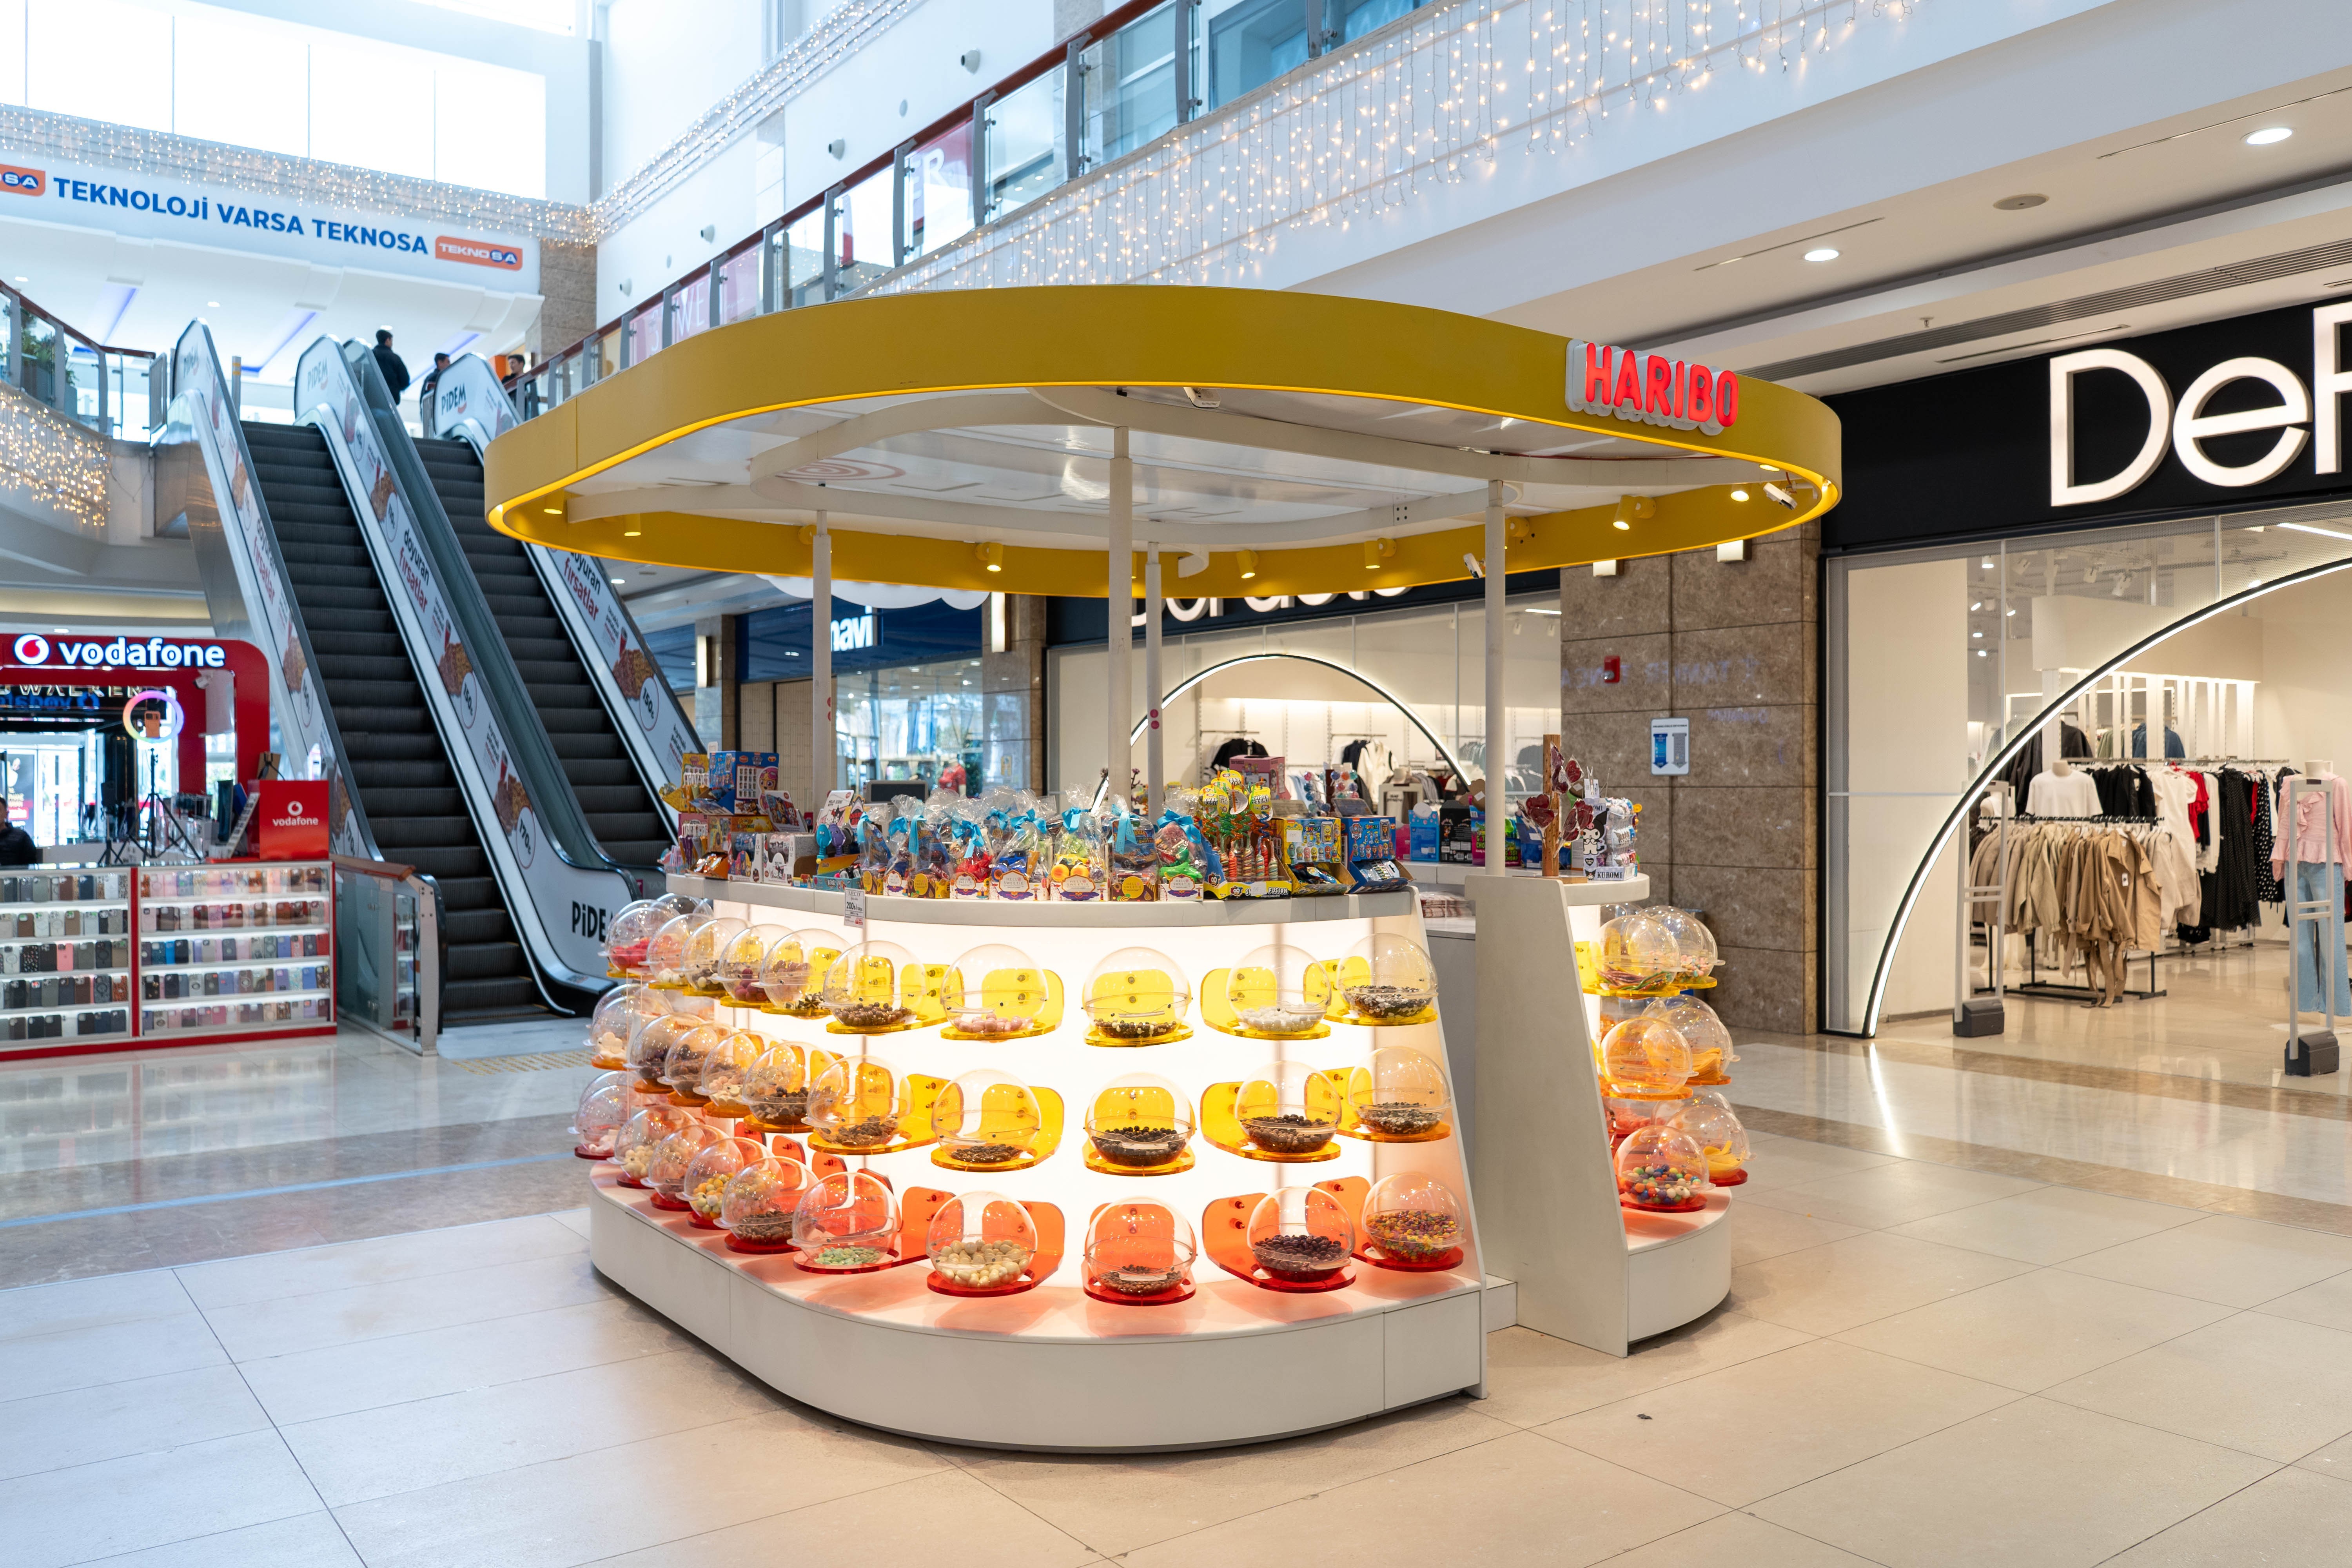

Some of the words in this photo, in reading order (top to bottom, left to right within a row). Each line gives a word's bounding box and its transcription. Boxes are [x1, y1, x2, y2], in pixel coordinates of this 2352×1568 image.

[0, 173, 38, 188] SA
[53, 177, 208, 220] TEKNOLOJİ
[217, 203, 304, 235] VARSA
[312, 219, 428, 255] TEKNOSA
[439, 242, 517, 263] TEKNOSA
[1585, 342, 1739, 427] HARIBO
[399, 546, 428, 613] fırsatlar
[404, 529, 429, 586] doyuran
[564, 557, 599, 621] fırsatlar
[58, 636, 226, 667] vodafone
[272, 816, 319, 826] vodafone
[572, 900, 614, 942] PiDE
